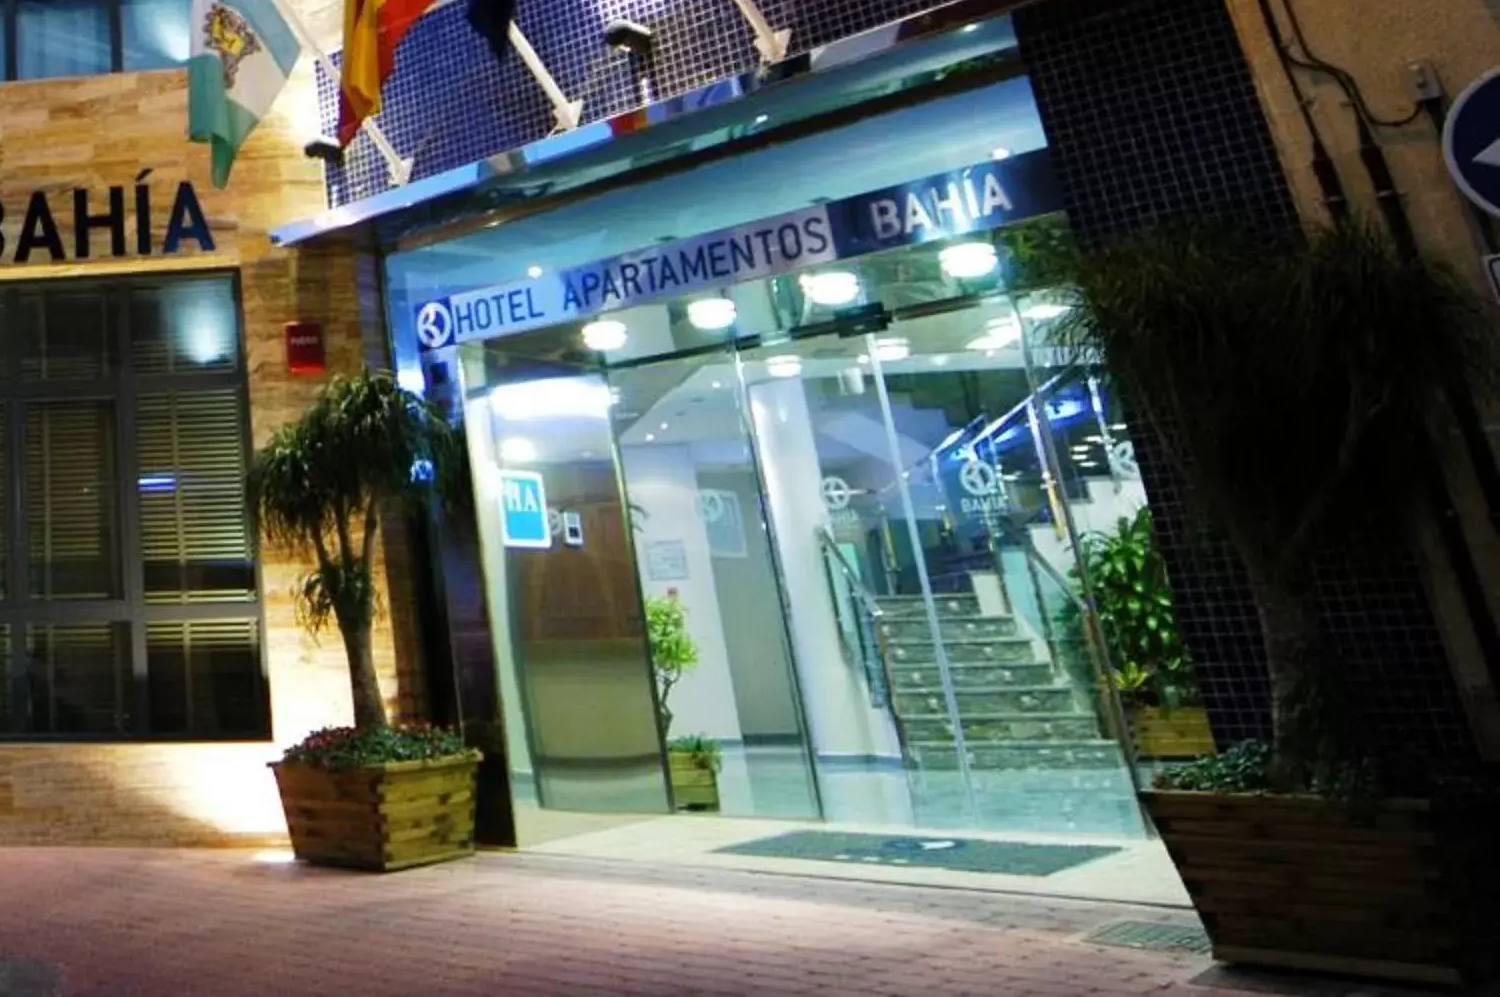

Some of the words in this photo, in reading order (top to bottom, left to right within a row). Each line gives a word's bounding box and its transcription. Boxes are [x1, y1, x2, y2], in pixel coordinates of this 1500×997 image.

[455, 286, 546, 334] HOTEL
[562, 215, 831, 312] APARTAMENTOS
[870, 167, 1014, 241] BAHÍA
